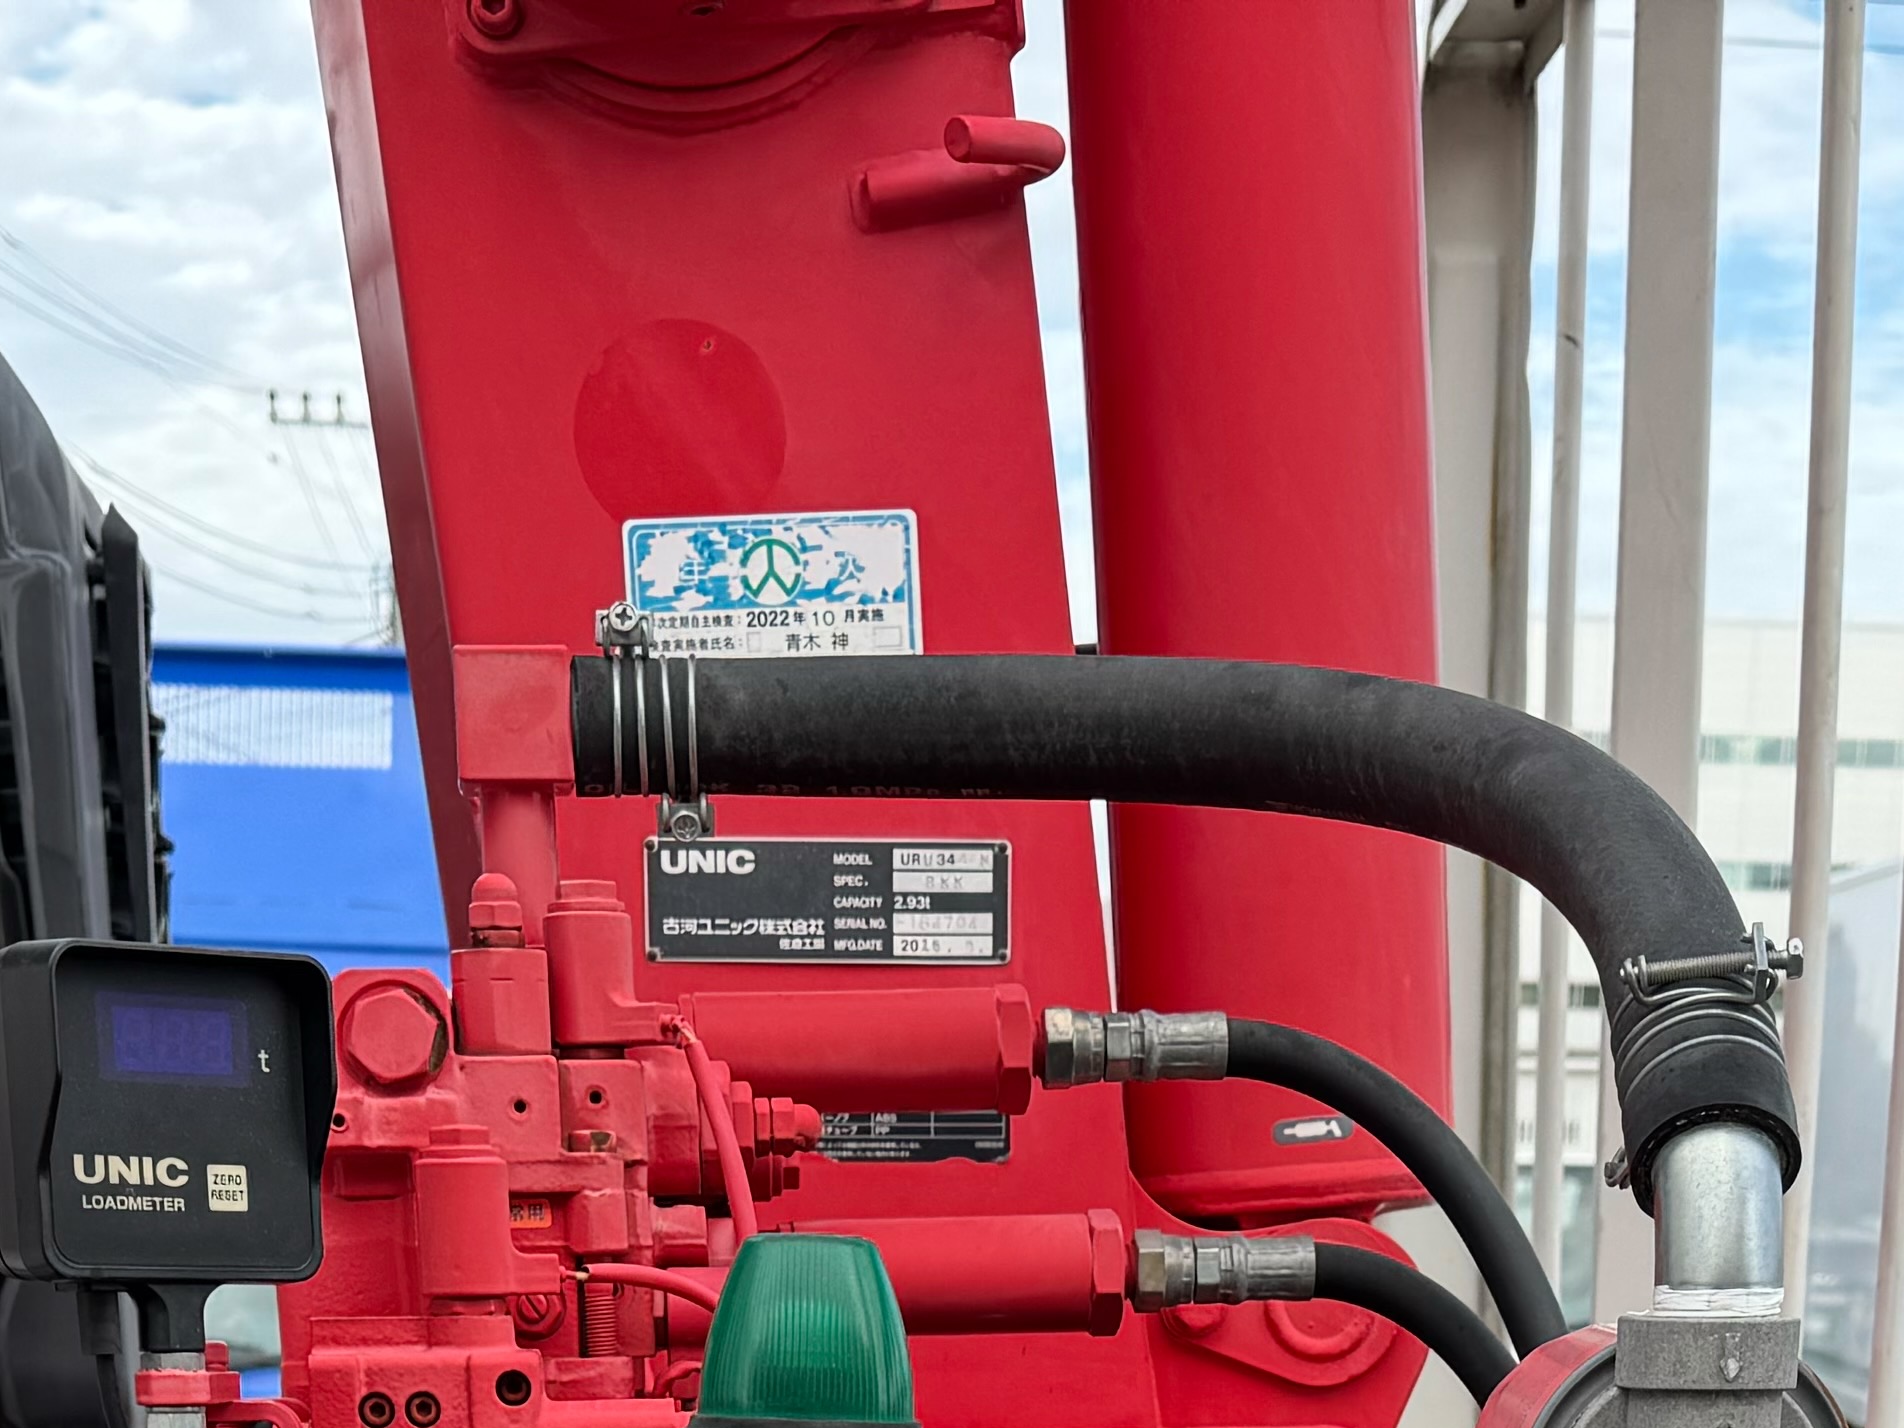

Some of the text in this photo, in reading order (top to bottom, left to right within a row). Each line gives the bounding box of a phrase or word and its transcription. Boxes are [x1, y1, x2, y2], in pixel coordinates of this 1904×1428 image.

[813, 611, 835, 626] 10
[660, 850, 755, 875] UNIC
[833, 854, 872, 866] MODEL
[833, 875, 868, 887] SPEC.
[833, 897, 882, 909] CAPACITY
[663, 919, 825, 935] 古河ユニック株式会社
[833, 918, 866, 930] SERIAL
[258, 1049, 270, 1073] t
[73, 1154, 189, 1188] UNIC
[212, 1173, 242, 1187] ZERO
[211, 1189, 244, 1203] RESET
[82, 1195, 186, 1212] LOADMETER
